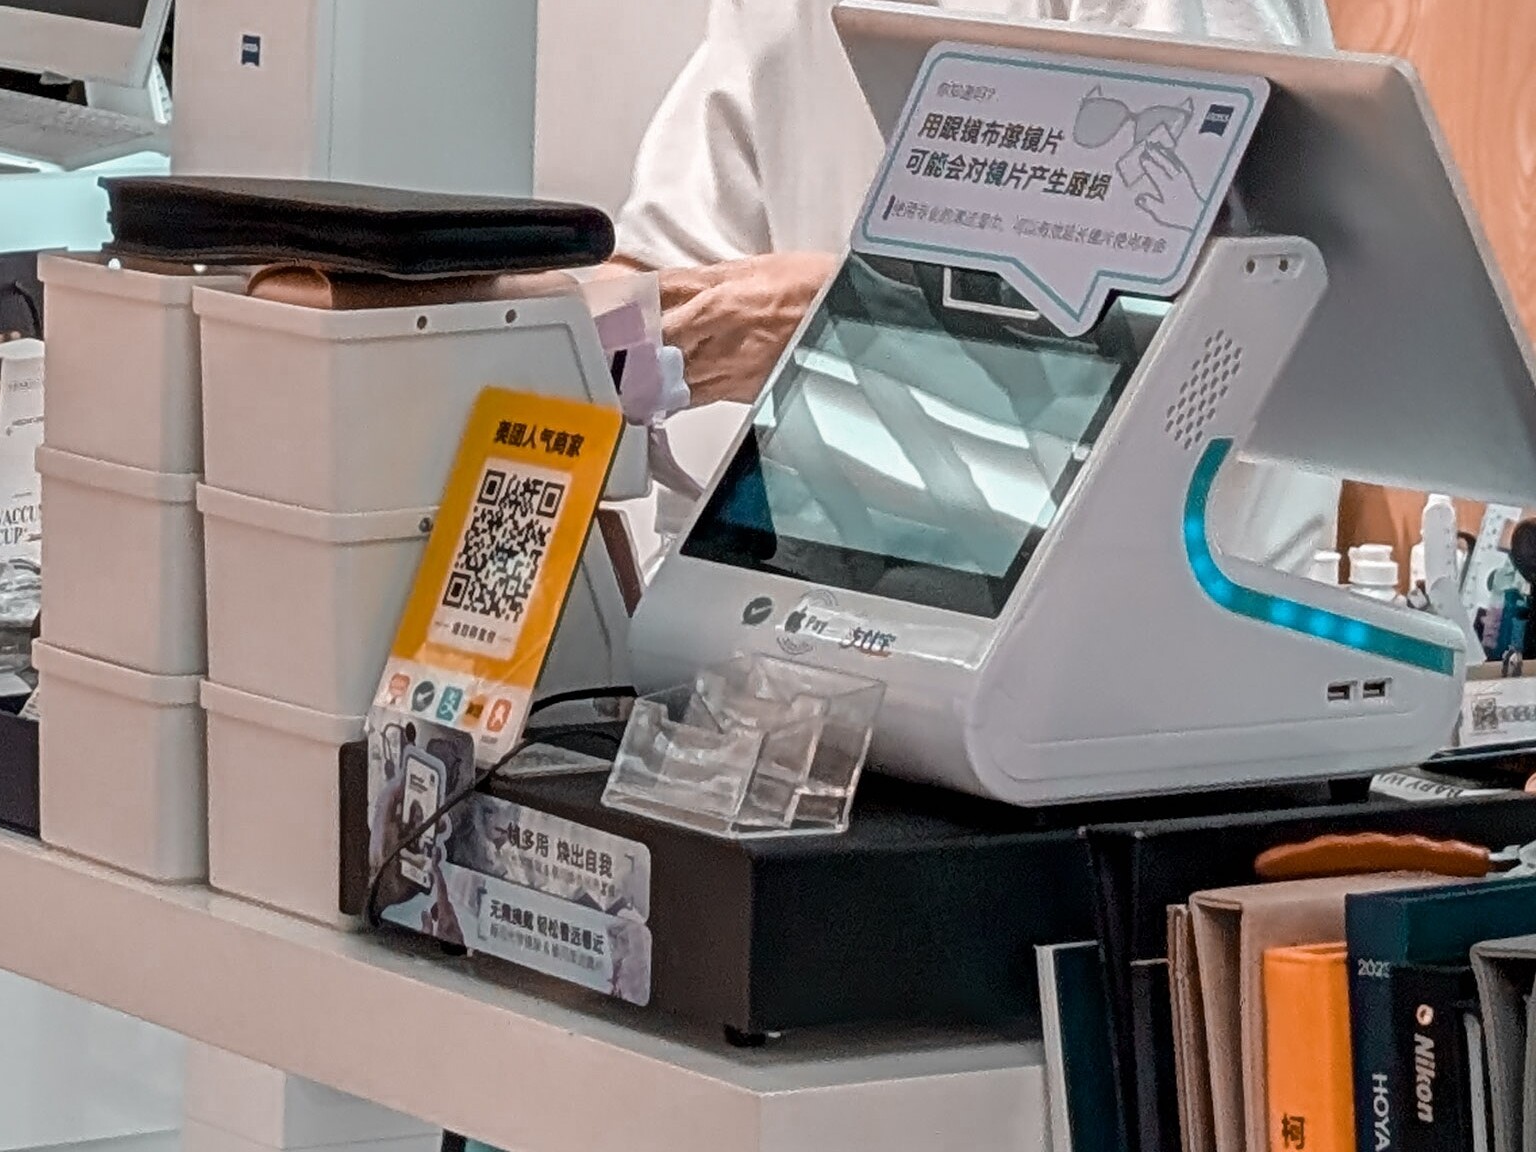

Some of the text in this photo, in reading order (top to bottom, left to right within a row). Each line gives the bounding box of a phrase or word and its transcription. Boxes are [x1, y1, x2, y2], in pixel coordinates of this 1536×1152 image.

[906, 147, 1114, 201] 可能会对镜片产生磨损
[1372, 1072, 1392, 1152] HOYA
[1414, 1032, 1436, 1124] Nikon
